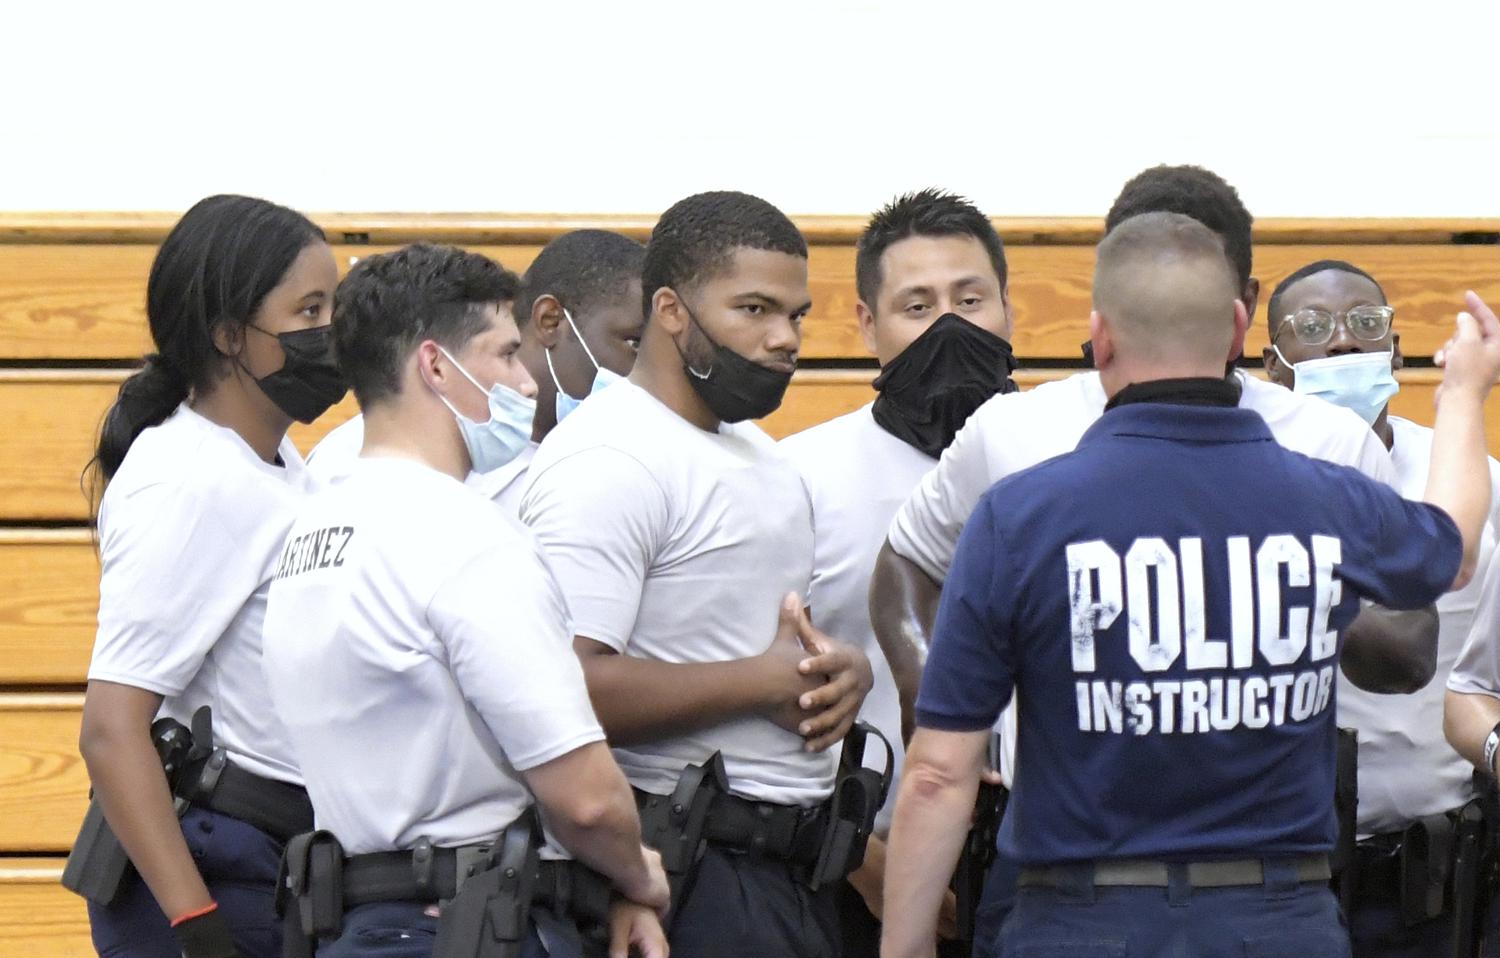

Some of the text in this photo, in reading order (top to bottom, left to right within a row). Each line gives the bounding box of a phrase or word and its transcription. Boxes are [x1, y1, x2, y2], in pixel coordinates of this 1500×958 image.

[274, 526, 354, 581] ARTINEZ
[1066, 533, 1342, 672] POLICE
[1076, 665, 1334, 735] INSTRUCTOR
